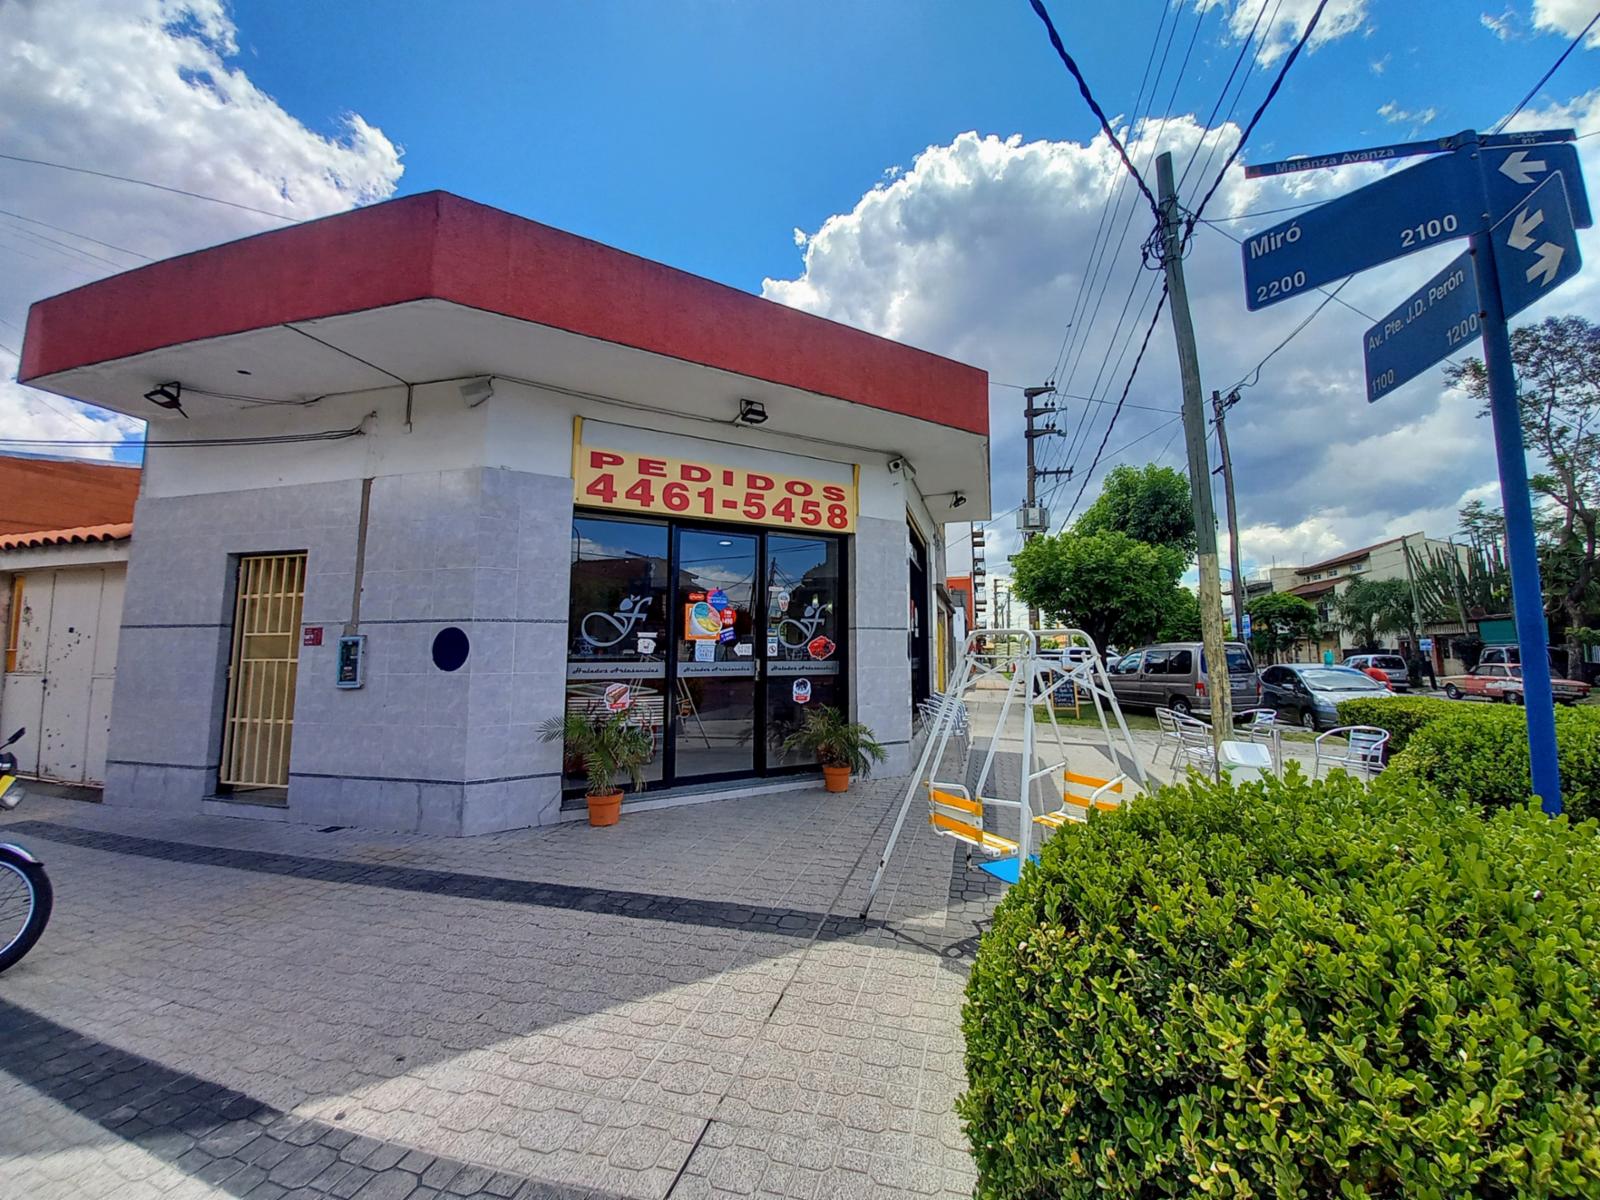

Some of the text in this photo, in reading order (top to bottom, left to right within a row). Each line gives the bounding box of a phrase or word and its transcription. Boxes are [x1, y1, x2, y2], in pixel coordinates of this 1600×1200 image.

[1275, 148, 1395, 174] Matanza Avanza
[1250, 221, 1302, 260] Miró
[1401, 214, 1459, 248] 2100
[1256, 271, 1307, 302] 2200
[1368, 269, 1464, 353] Av. Pte. J.D. Perón
[1446, 313, 1478, 346] 1200
[1371, 369, 1394, 394] 1100
[590, 451, 846, 501] PEDIDOS
[586, 473, 848, 529] 4461-5458
